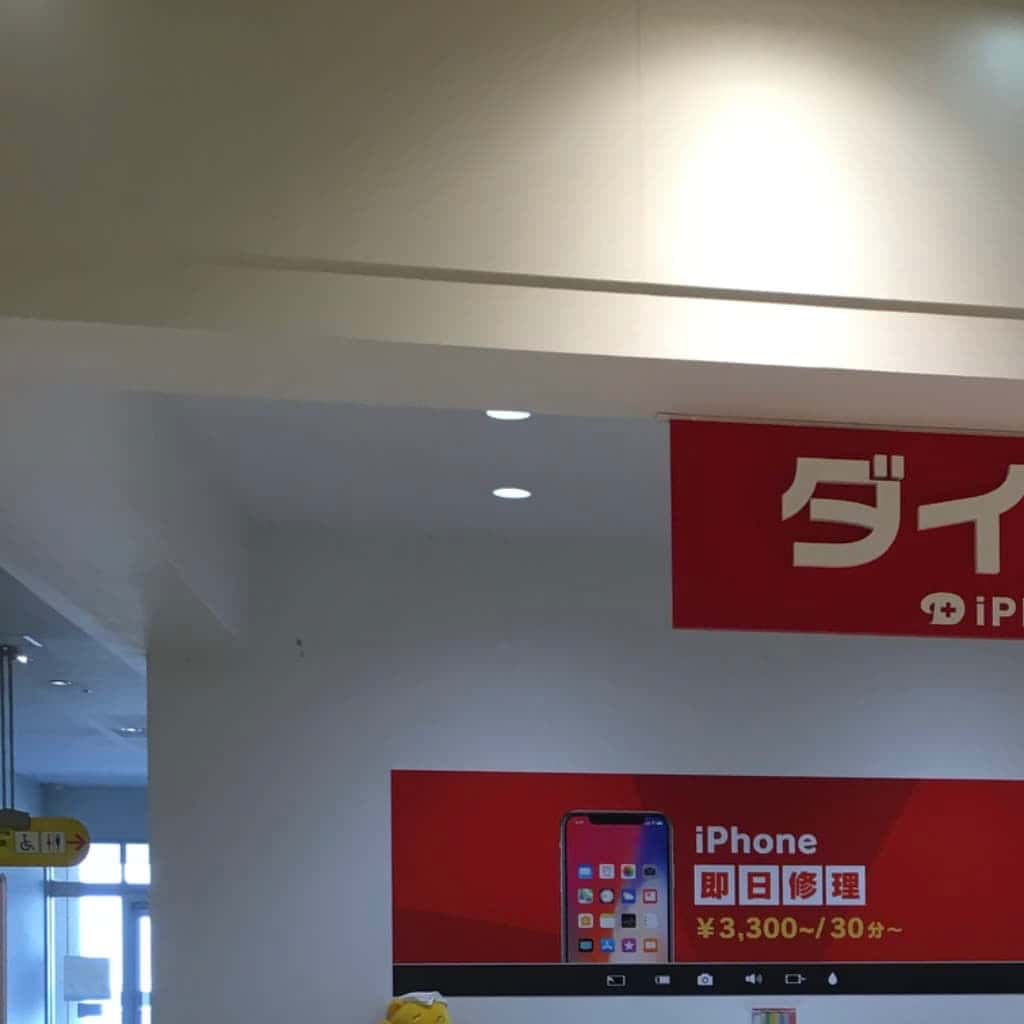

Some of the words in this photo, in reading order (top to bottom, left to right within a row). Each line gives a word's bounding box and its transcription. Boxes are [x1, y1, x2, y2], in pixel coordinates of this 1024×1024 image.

[695, 826, 818, 854] iPhone
[700, 870, 861, 900] 即日修理
